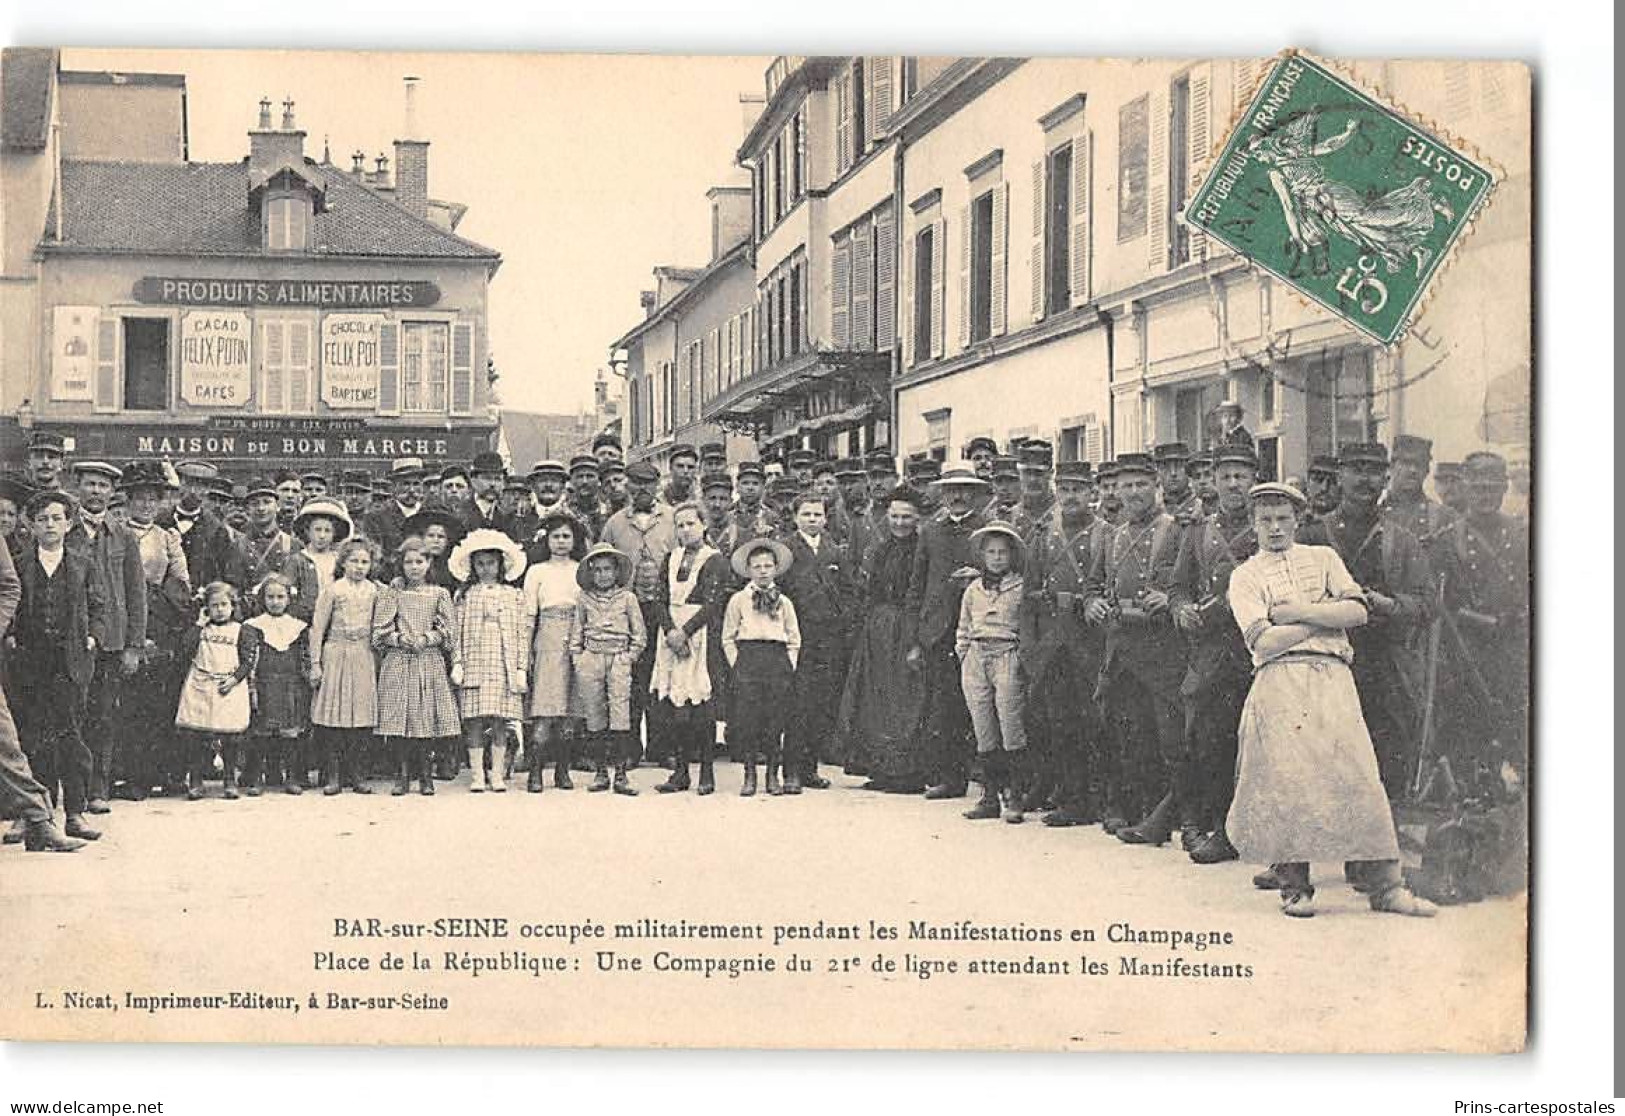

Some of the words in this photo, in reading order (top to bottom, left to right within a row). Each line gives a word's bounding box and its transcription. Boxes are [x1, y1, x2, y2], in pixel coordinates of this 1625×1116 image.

[1402, 135, 1475, 191] POSTES
[162, 280, 270, 302] PRODUITS
[274, 281, 415, 304] ALIMENTAIRES
[194, 318, 239, 332] CACAO
[184, 336, 214, 366] FELIX
[216, 335, 248, 367] POTIN
[325, 341, 354, 367] FELIX
[137, 437, 235, 453] MAISON
[247, 442, 269, 453] DU
[282, 438, 326, 453] BON
[343, 438, 448, 455] MARCHE
[334, 918, 509, 938] BAR-sur-SEINE
[520, 918, 605, 944] occupée
[614, 918, 763, 939] militairement
[773, 920, 860, 945] pendant
[869, 920, 898, 940] les
[908, 920, 1063, 942] Manifestations
[1070, 929, 1096, 942] en
[1106, 923, 1234, 947] Champagne
[313, 951, 370, 970] Place
[379, 951, 404, 970] de
[412, 951, 431, 970] la
[596, 951, 642, 971] Une
[652, 951, 776, 979] Compagnie
[785, 953, 812, 972] du
[871, 953, 896, 973] de
[905, 953, 958, 979] ligne
[967, 955, 1070, 975] attendant
[1080, 955, 1109, 976] les
[1118, 956, 1253, 978] Manifestants
[36, 992, 54, 1009] L.
[63, 992, 118, 1012] Nicat,
[125, 992, 300, 1014] Imprimeur-Editeur,
[308, 992, 319, 1009] à
[326, 992, 448, 1010] Bar-sur-Seine
